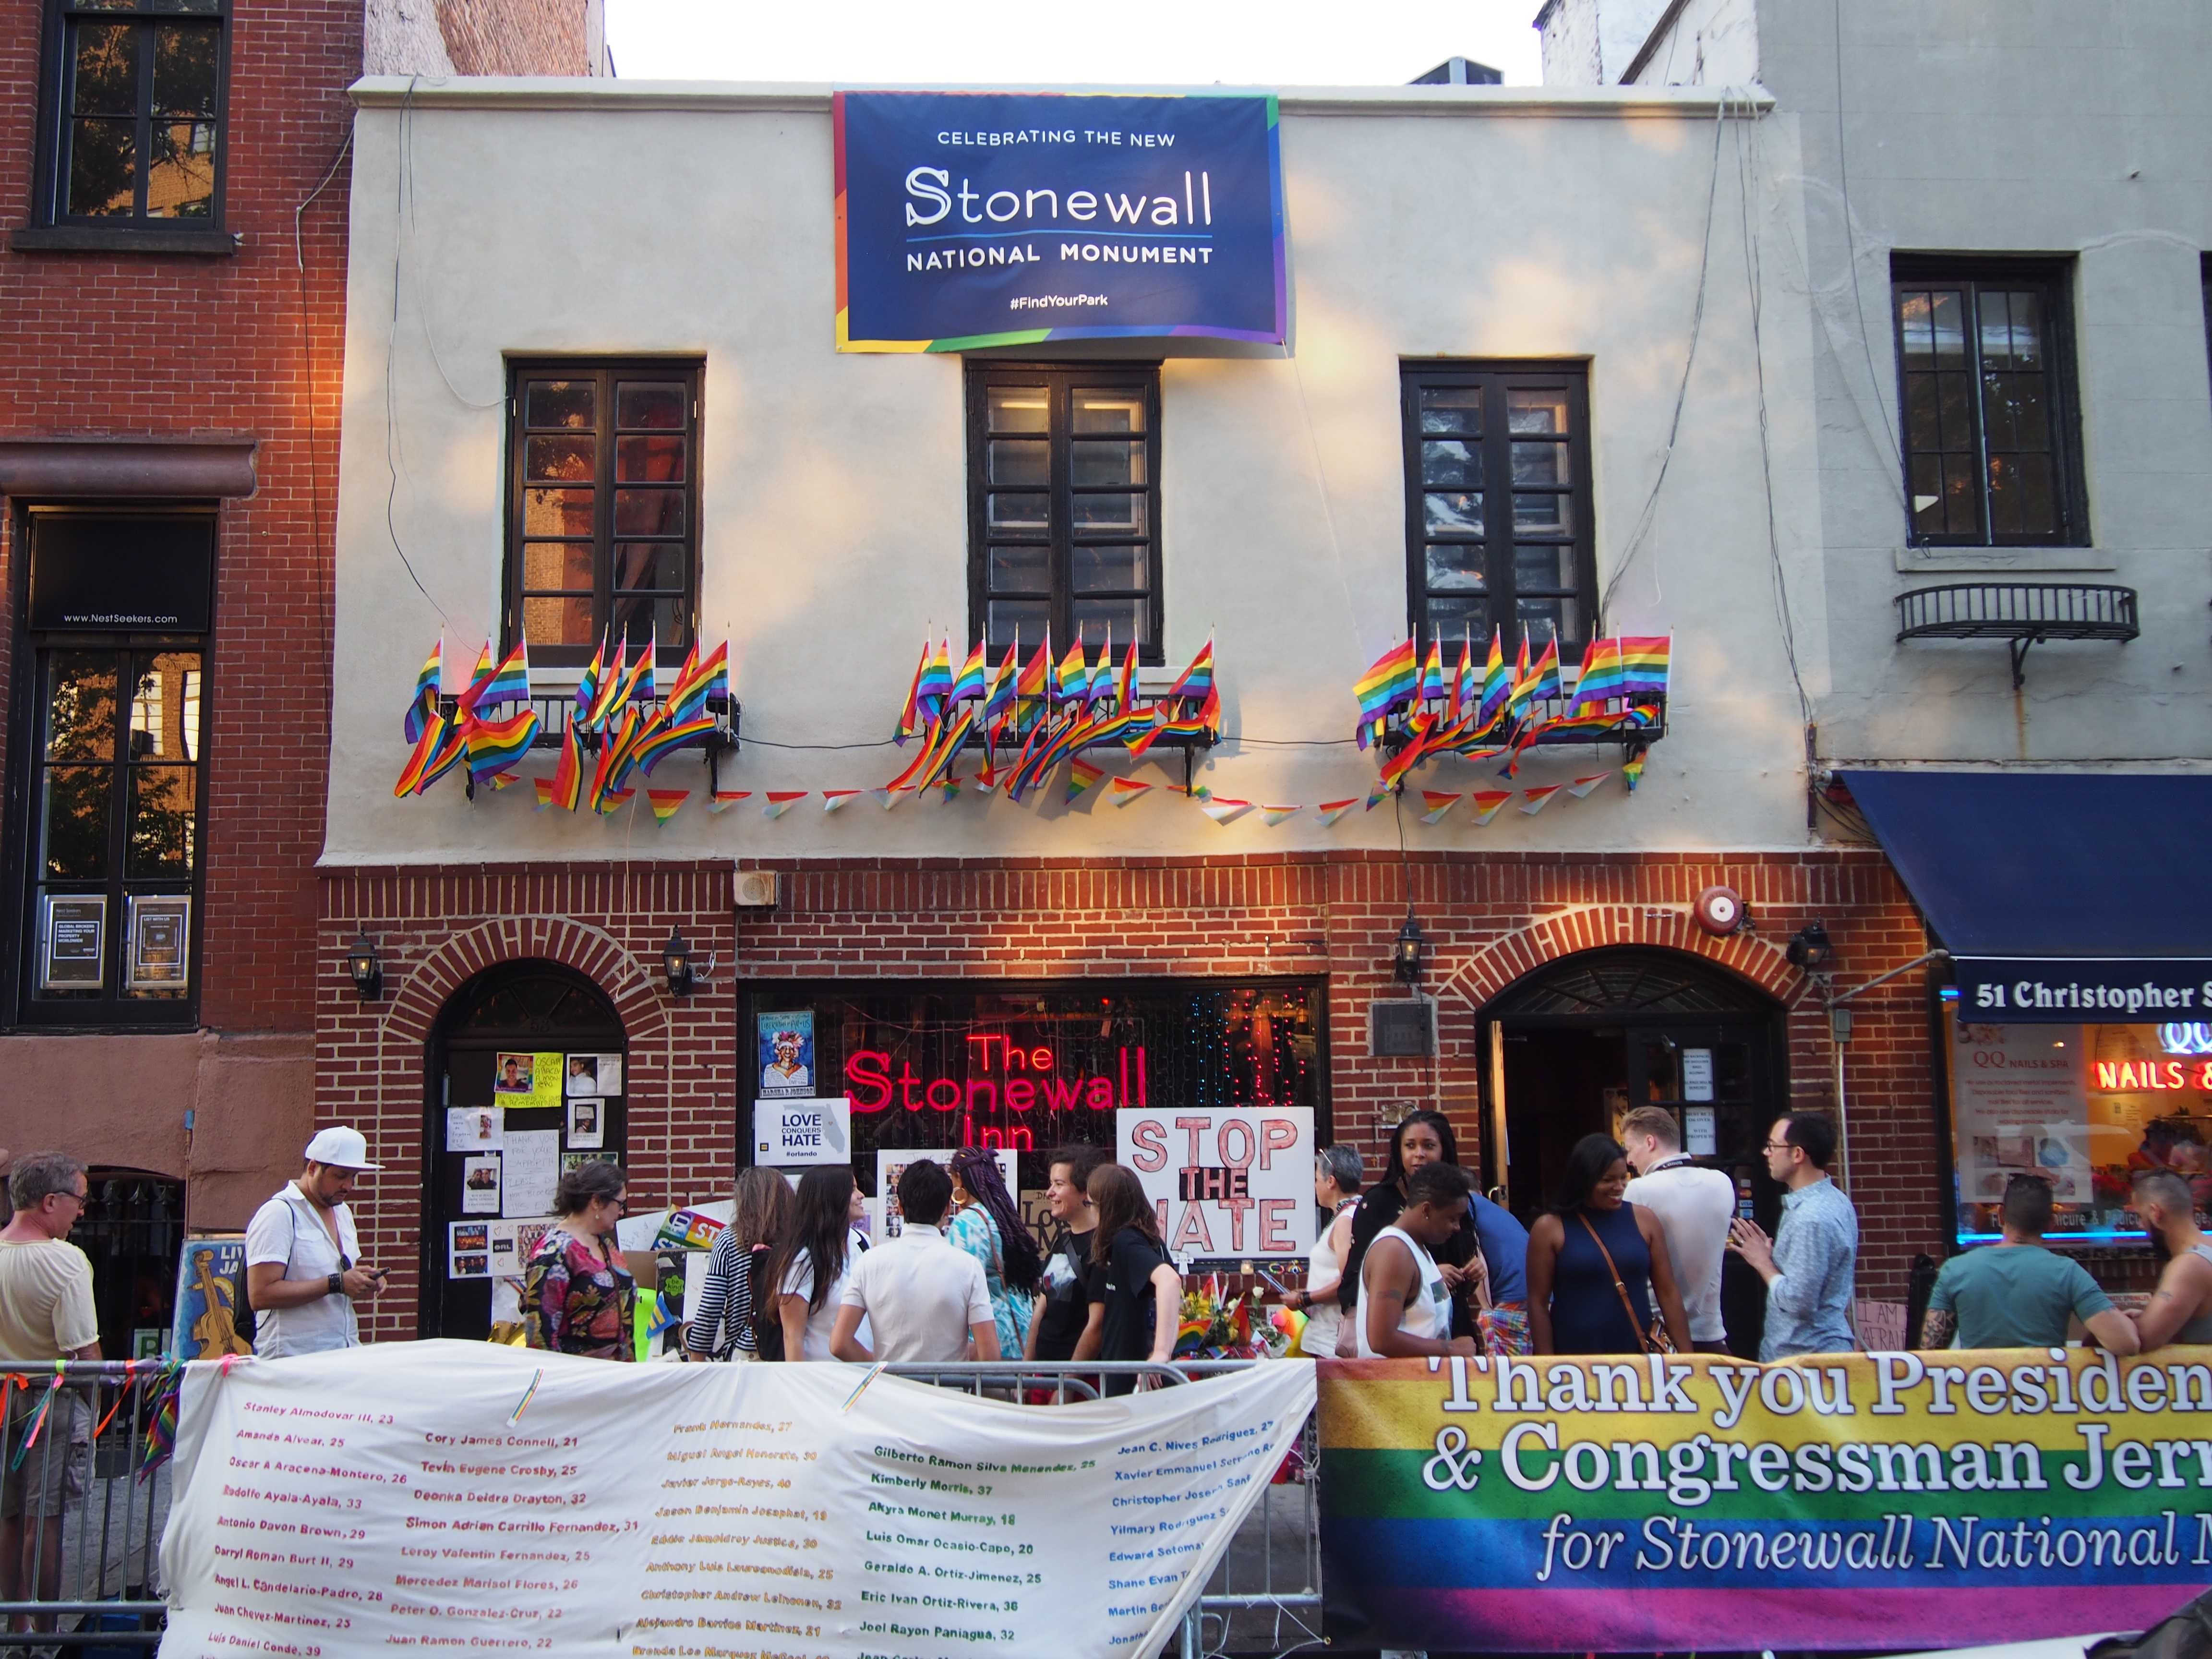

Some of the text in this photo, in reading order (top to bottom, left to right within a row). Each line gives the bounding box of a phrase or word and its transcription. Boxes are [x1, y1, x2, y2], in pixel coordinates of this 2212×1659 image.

[938, 130, 1175, 147] CELEBRATING THE NEW
[906, 167, 1211, 227] Stonewall
[908, 243, 1213, 271] NATIONAL MONUMENT
[1010, 294, 1108, 310] #FindYourPark
[64, 614, 177, 623] www.NestSeekers.com
[1977, 984, 2006, 1008] 51
[2014, 981, 2194, 1013] Christopher
[536, 1057, 561, 1066] OSCAR
[966, 1034, 1053, 1071] The
[1974, 1051, 2069, 1069] QQ NAILS & SPA
[846, 1047, 1146, 1114] Stonewall
[2098, 1061, 2184, 1089] NAILS
[782, 1115, 821, 1127] LOVE
[505, 1135, 557, 1147] THANK YOU
[782, 1134, 821, 1146] HATE
[964, 1115, 1033, 1152] Inn
[1132, 1117, 1298, 1172] STOP
[1180, 1167, 1248, 1200] THE
[1858, 1301, 1897, 1325] I AM
[1428, 1354, 1699, 1412] Thank
[1712, 1362, 1855, 1429] you
[244, 1402, 287, 1416] Stanley
[289, 1406, 355, 1420] Almodovar
[378, 1413, 395, 1425] 23
[236, 1429, 345, 1448] Amanda Alvear, 25
[425, 1433, 578, 1449] Cory James Connell, 21
[1118, 1420, 1274, 1455] Jean C. Nives Rodriguez, 27
[229, 1455, 407, 1484] Oscar A Aracena-Montero, 26
[420, 1460, 577, 1479] Tevin Eugene Crosby, 25
[874, 1445, 1095, 1475] Gilberto Ramon Silva Menendez, 25
[1115, 1460, 1216, 1480] Xavier Emmanuel
[1423, 1427, 1482, 1490] &
[1501, 1420, 2048, 1505] Congressman
[871, 1473, 993, 1496] Kimberly Morris, 37
[223, 1484, 362, 1510] Rodolfo Ayala-Ayala, 33
[412, 1489, 587, 1507] Deonka Deidra Drayton, 32
[1112, 1494, 1181, 1507] Christopher
[406, 1517, 638, 1536] Simon Adrian Carrillo Fernandez, 31
[868, 1502, 1015, 1527] Akyra Monet Murray, 18
[217, 1515, 366, 1539] Antonio Davon Brown, 29
[1110, 1525, 1155, 1535] Yilmary
[866, 1530, 1033, 1557] Luis Omar Ocasio-Capo, 20
[1537, 1514, 1624, 1581] for
[1636, 1512, 1915, 1571] Stonewall
[1927, 1511, 2180, 1568] National
[215, 1544, 244, 1560] Darryl
[245, 1548, 285, 1563] Roman
[289, 1553, 317, 1565] Burt
[338, 1557, 353, 1569] 29
[1109, 1550, 1154, 1562] Edward
[1108, 1575, 1178, 1590] Shane Evan
[641, 1588, 842, 1612] Christopher Andrew Leinonen, 32
[1107, 1605, 1146, 1617] Martin
